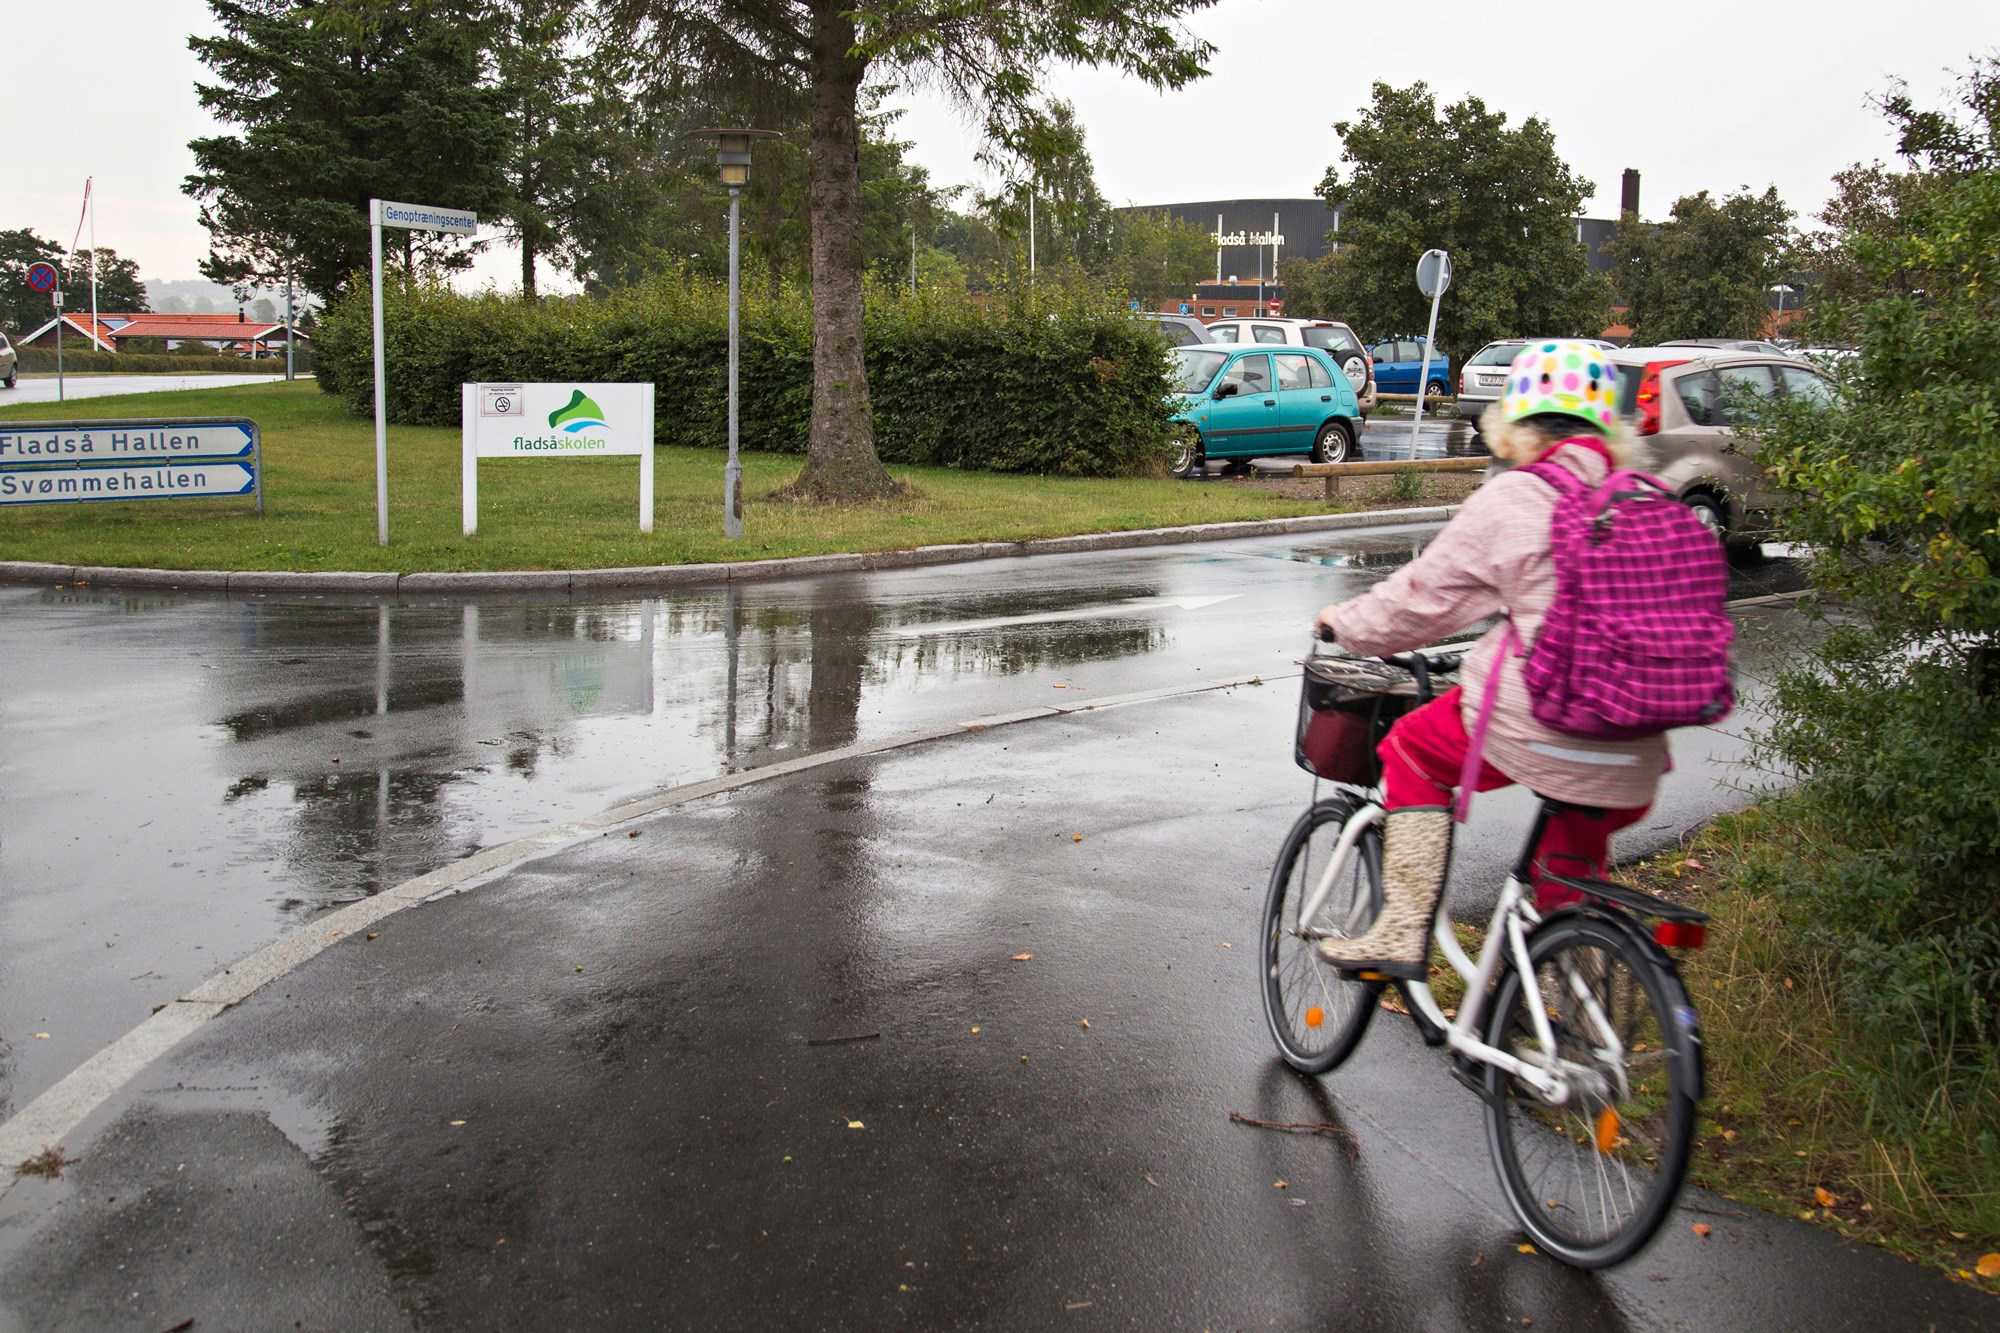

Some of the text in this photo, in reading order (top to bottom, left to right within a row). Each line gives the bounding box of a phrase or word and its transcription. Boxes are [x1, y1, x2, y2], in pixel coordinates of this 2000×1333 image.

[386, 206, 475, 229] Genoptræningscenter
[0, 432, 200, 456] Fladså Hallen
[513, 435, 606, 451] fladsåskolen
[1, 470, 207, 496] Svømmehallen
